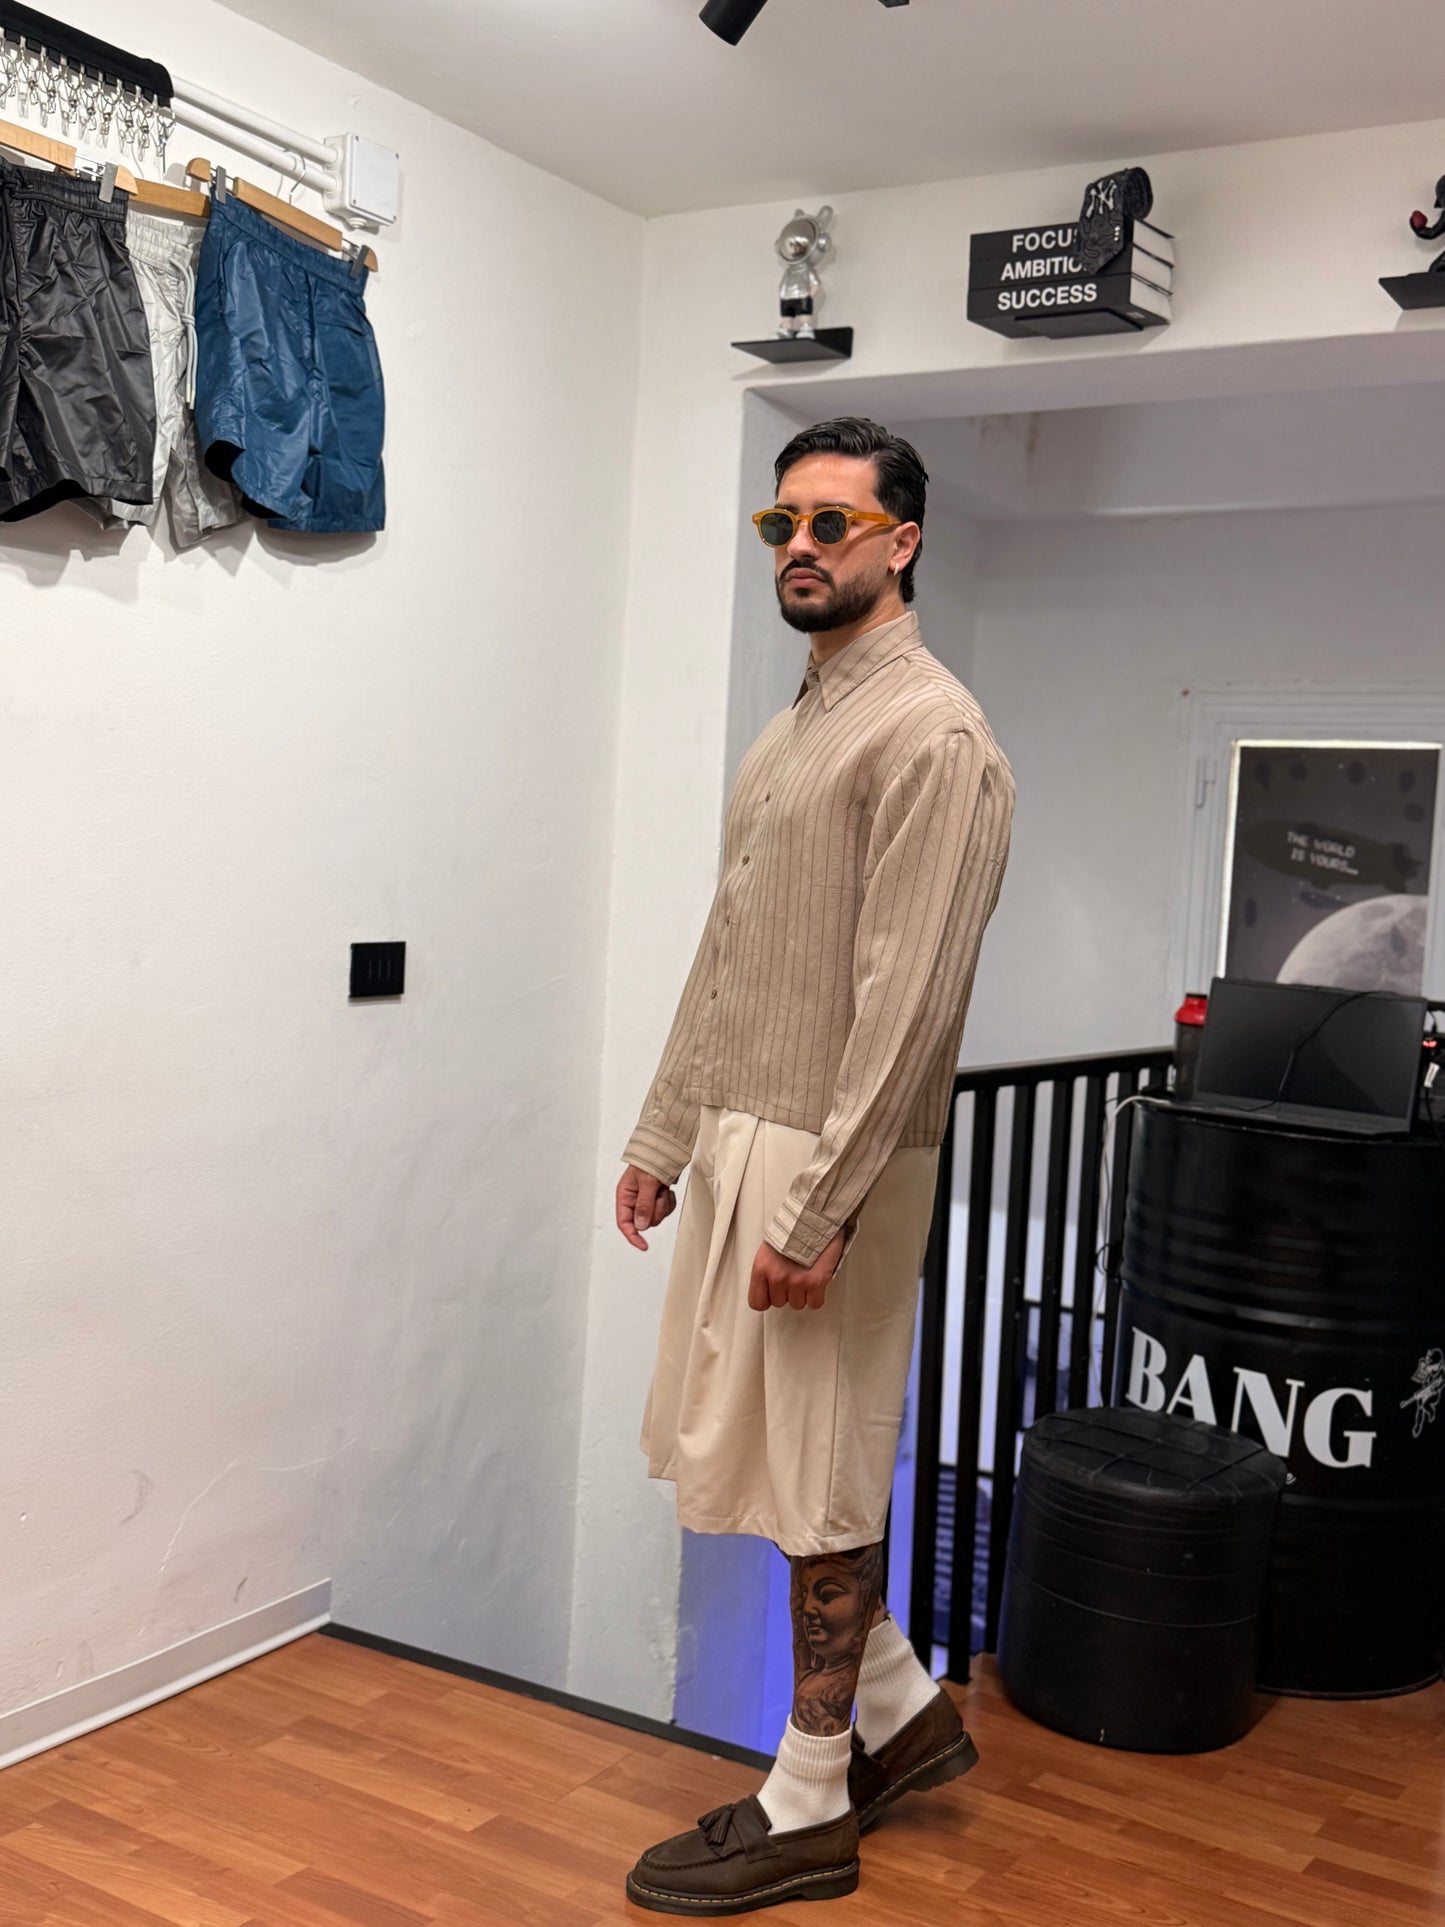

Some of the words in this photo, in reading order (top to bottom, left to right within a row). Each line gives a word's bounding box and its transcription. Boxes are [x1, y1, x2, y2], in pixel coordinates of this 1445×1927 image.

[1012, 228, 1078, 252] FOCU
[1001, 256, 1088, 280] AMBITIO
[997, 283, 1097, 310] SUCCESS
[1286, 831, 1307, 848] THE
[1313, 838, 1356, 858] WORLD
[1291, 848, 1305, 862] IS
[1125, 1326, 1377, 1469] BANG
